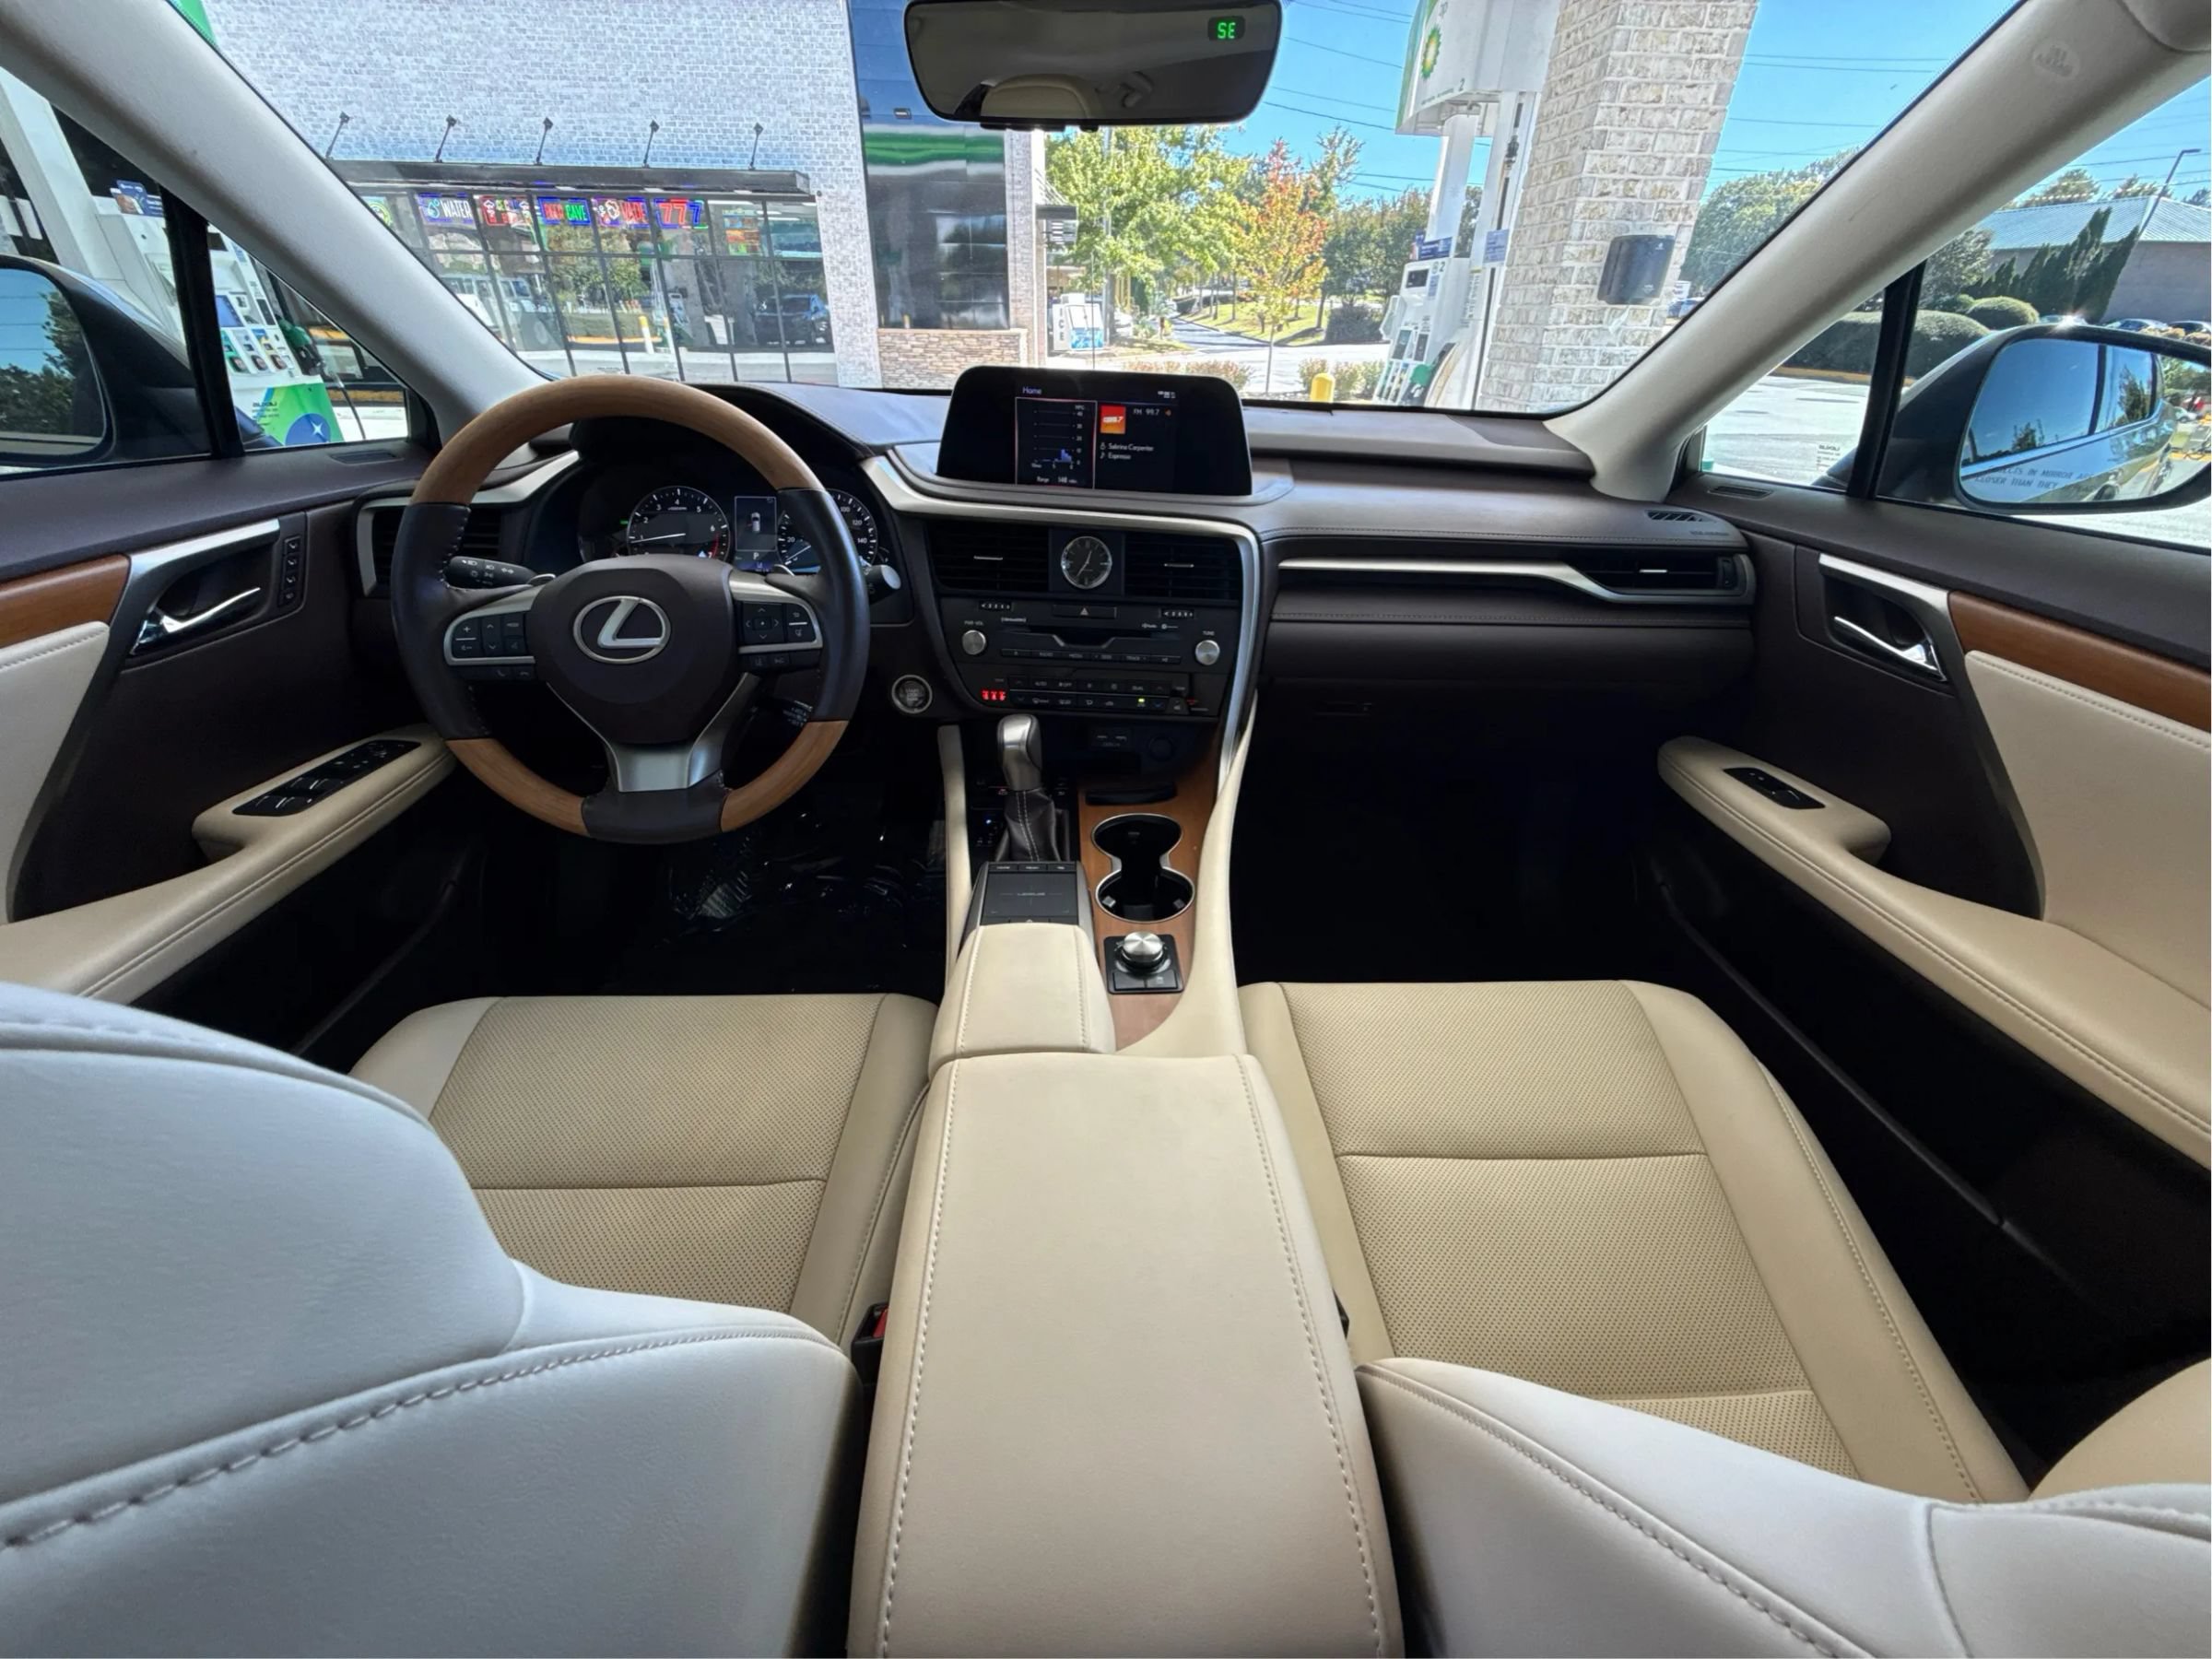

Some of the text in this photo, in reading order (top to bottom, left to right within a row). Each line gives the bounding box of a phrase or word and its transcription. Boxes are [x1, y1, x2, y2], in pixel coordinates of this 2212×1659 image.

[1218, 22, 1236, 39] SE
[441, 200, 473, 218] WATER
[566, 204, 588, 221] CAVE
[659, 202, 702, 225] 777
[1022, 386, 1042, 394] Home
[2011, 477, 2033, 488] THAN
[2038, 480, 2059, 488] THEY
[753, 552, 759, 560] P
